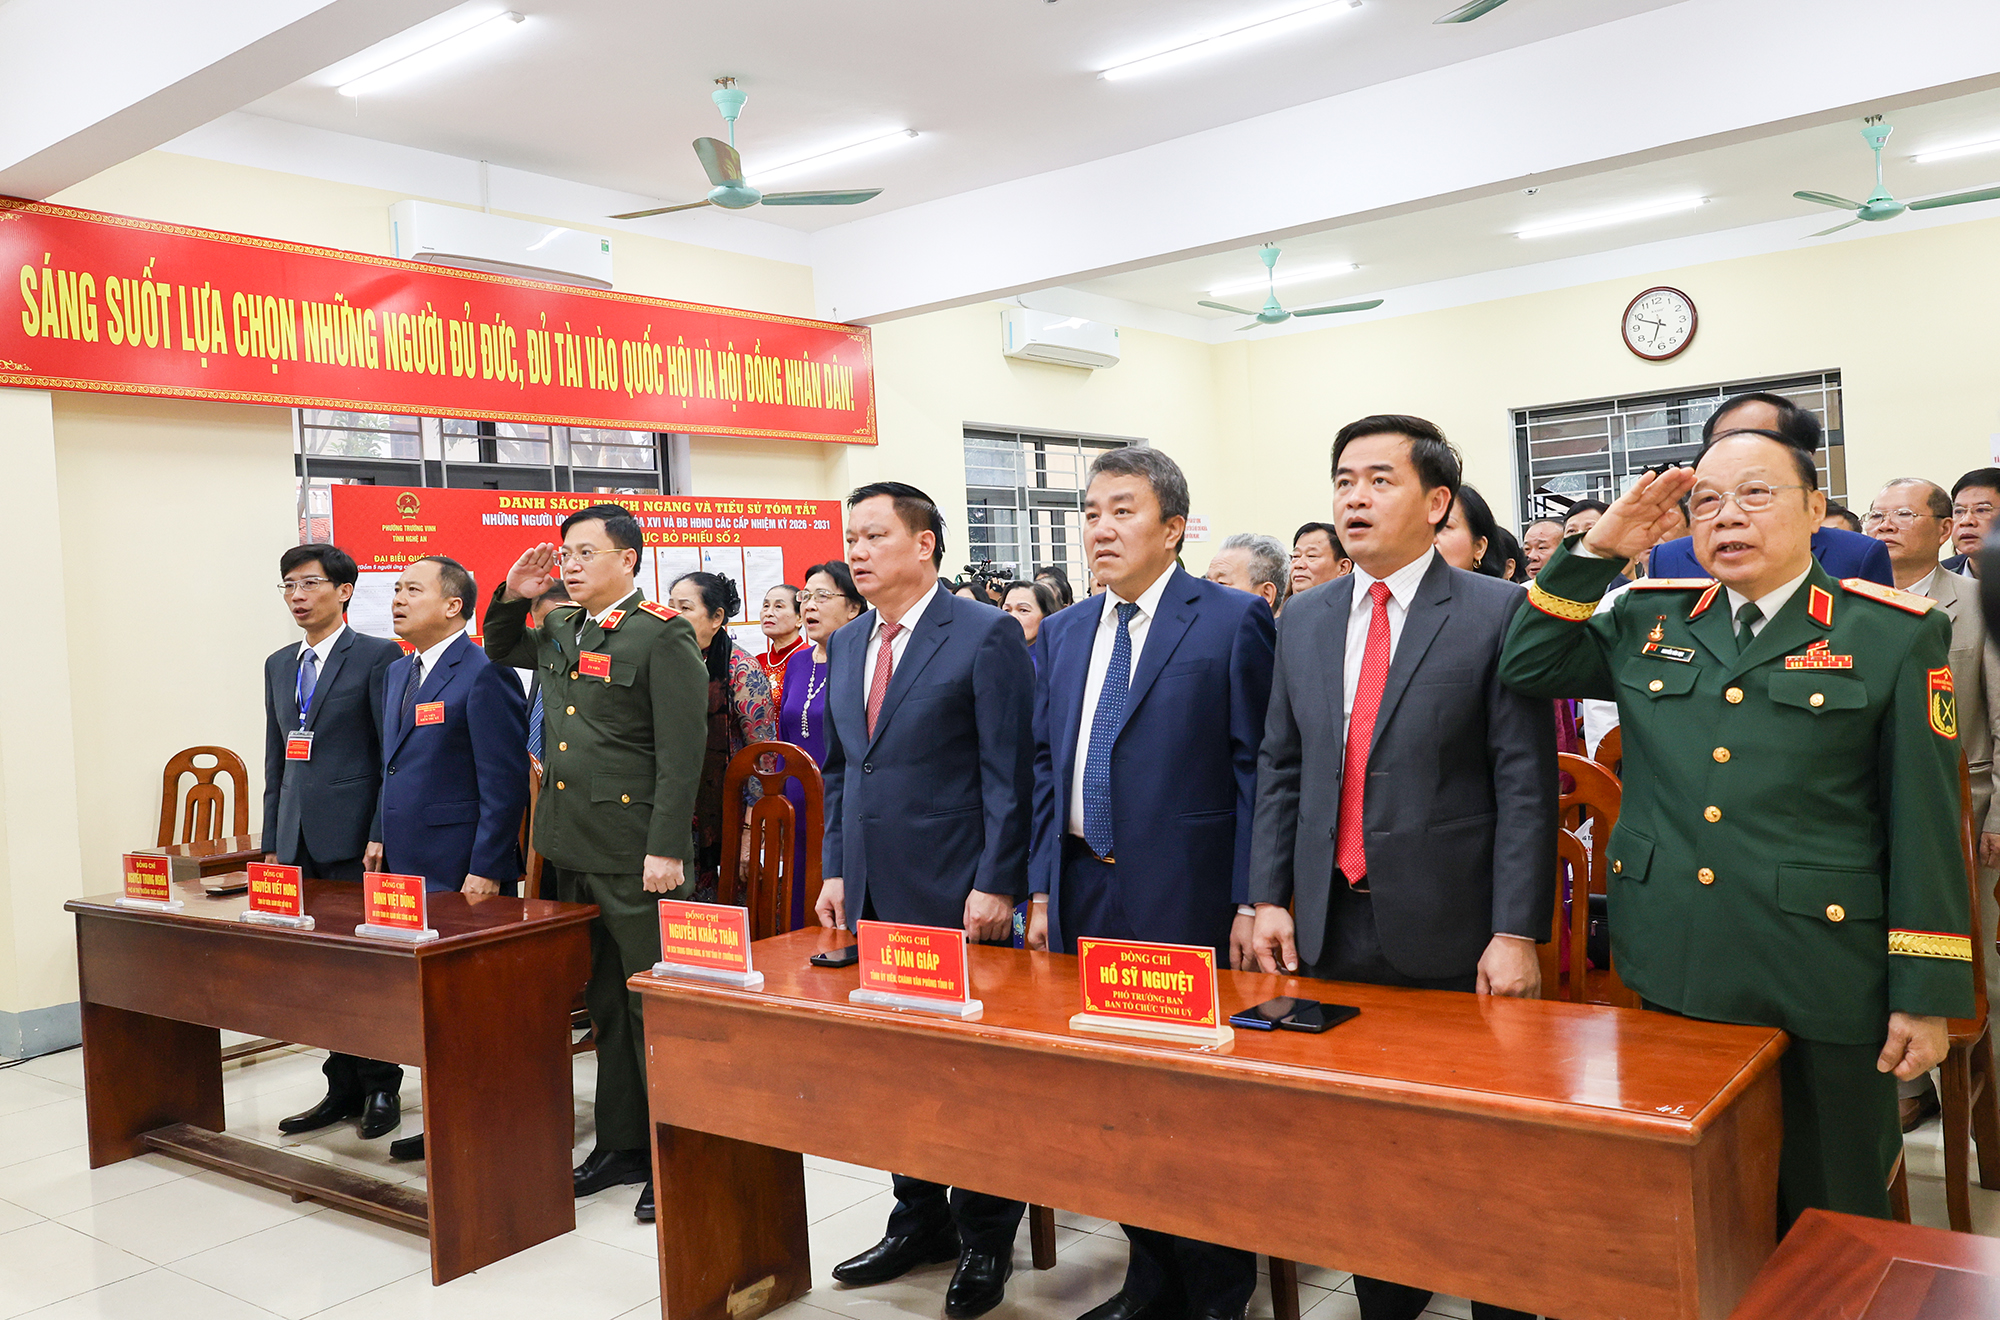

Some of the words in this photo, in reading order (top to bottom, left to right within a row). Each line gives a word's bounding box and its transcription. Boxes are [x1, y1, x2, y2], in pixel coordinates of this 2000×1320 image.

[1651, 297, 1662, 305] 12
[1634, 313, 1644, 321] 10
[1679, 315, 1687, 323] 3
[20, 253, 100, 342] SÁNG
[106, 257, 171, 348] SUỐT
[181, 281, 228, 368] LỰA
[232, 291, 298, 374] CHỌN
[301, 293, 379, 369] NHỮNG
[383, 301, 446, 375] NGƯỜI
[449, 301, 475, 379] ĐỦ
[479, 313, 524, 390] ĐỨC,
[527, 311, 552, 385] ĐỦ
[554, 321, 583, 388] TÀI
[584, 326, 619, 391] VÀO
[621, 324, 664, 399] QUỐC
[667, 342, 692, 408] HỘI
[694, 340, 717, 399] VÀ
[718, 342, 742, 412] HỘI
[744, 338, 782, 405] ĐỒNG
[784, 351, 822, 410] NHÂN
[824, 354, 855, 411] DÂN!
[1647, 340, 1654, 348] 7
[1657, 342, 1666, 350] 6
[499, 497, 546, 509] DANH
[550, 496, 590, 510] SÁCH
[643, 501, 691, 513] NGANG
[698, 500, 712, 513] VÀ
[715, 500, 744, 514] TIỂU
[748, 501, 762, 514] SỬ
[765, 502, 793, 515] TÓM
[795, 501, 817, 515] TẮT
[482, 512, 519, 526] NHỮNG
[521, 512, 552, 526] NGƯỜI
[647, 517, 661, 528] XVI
[663, 515, 675, 528] VÀ
[676, 518, 688, 529] ĐB
[690, 518, 713, 529] HĐND
[715, 516, 732, 529] CÁC
[733, 515, 750, 529] CẤP
[751, 517, 776, 531] NHIỆM
[777, 517, 788, 530] KỲ
[789, 519, 807, 530] 2026
[813, 519, 831, 530] 2031
[642, 531, 660, 546] ỰC
[662, 530, 678, 543] BỎ
[682, 529, 713, 543] PHIẾU
[716, 529, 731, 543] SỐ
[733, 533, 740, 543] 2
[374, 555, 388, 564] ĐẠI
[390, 552, 406, 562] BIỂU
[706, 913, 719, 922] CHÍ
[669, 920, 697, 941] NGUYỄN
[698, 922, 718, 944] KHẮC
[719, 927, 738, 949] THẬN
[914, 936, 930, 946] CHÍ
[881, 945, 893, 965] LÊ
[894, 947, 914, 969] VĂN
[916, 950, 940, 971] GIÁP
[1151, 953, 1171, 966] CHÍ
[1100, 962, 1118, 985] HỒ
[1121, 966, 1139, 986] SỸ
[1142, 970, 1194, 995] NGUYỆT
[1113, 990, 1130, 1000] PHÓ
[1131, 992, 1165, 1003] TRƯỞNG
[1166, 996, 1183, 1005] BAN
[1104, 1000, 1121, 1008] BAN
[1135, 1001, 1159, 1013] CHỨC
